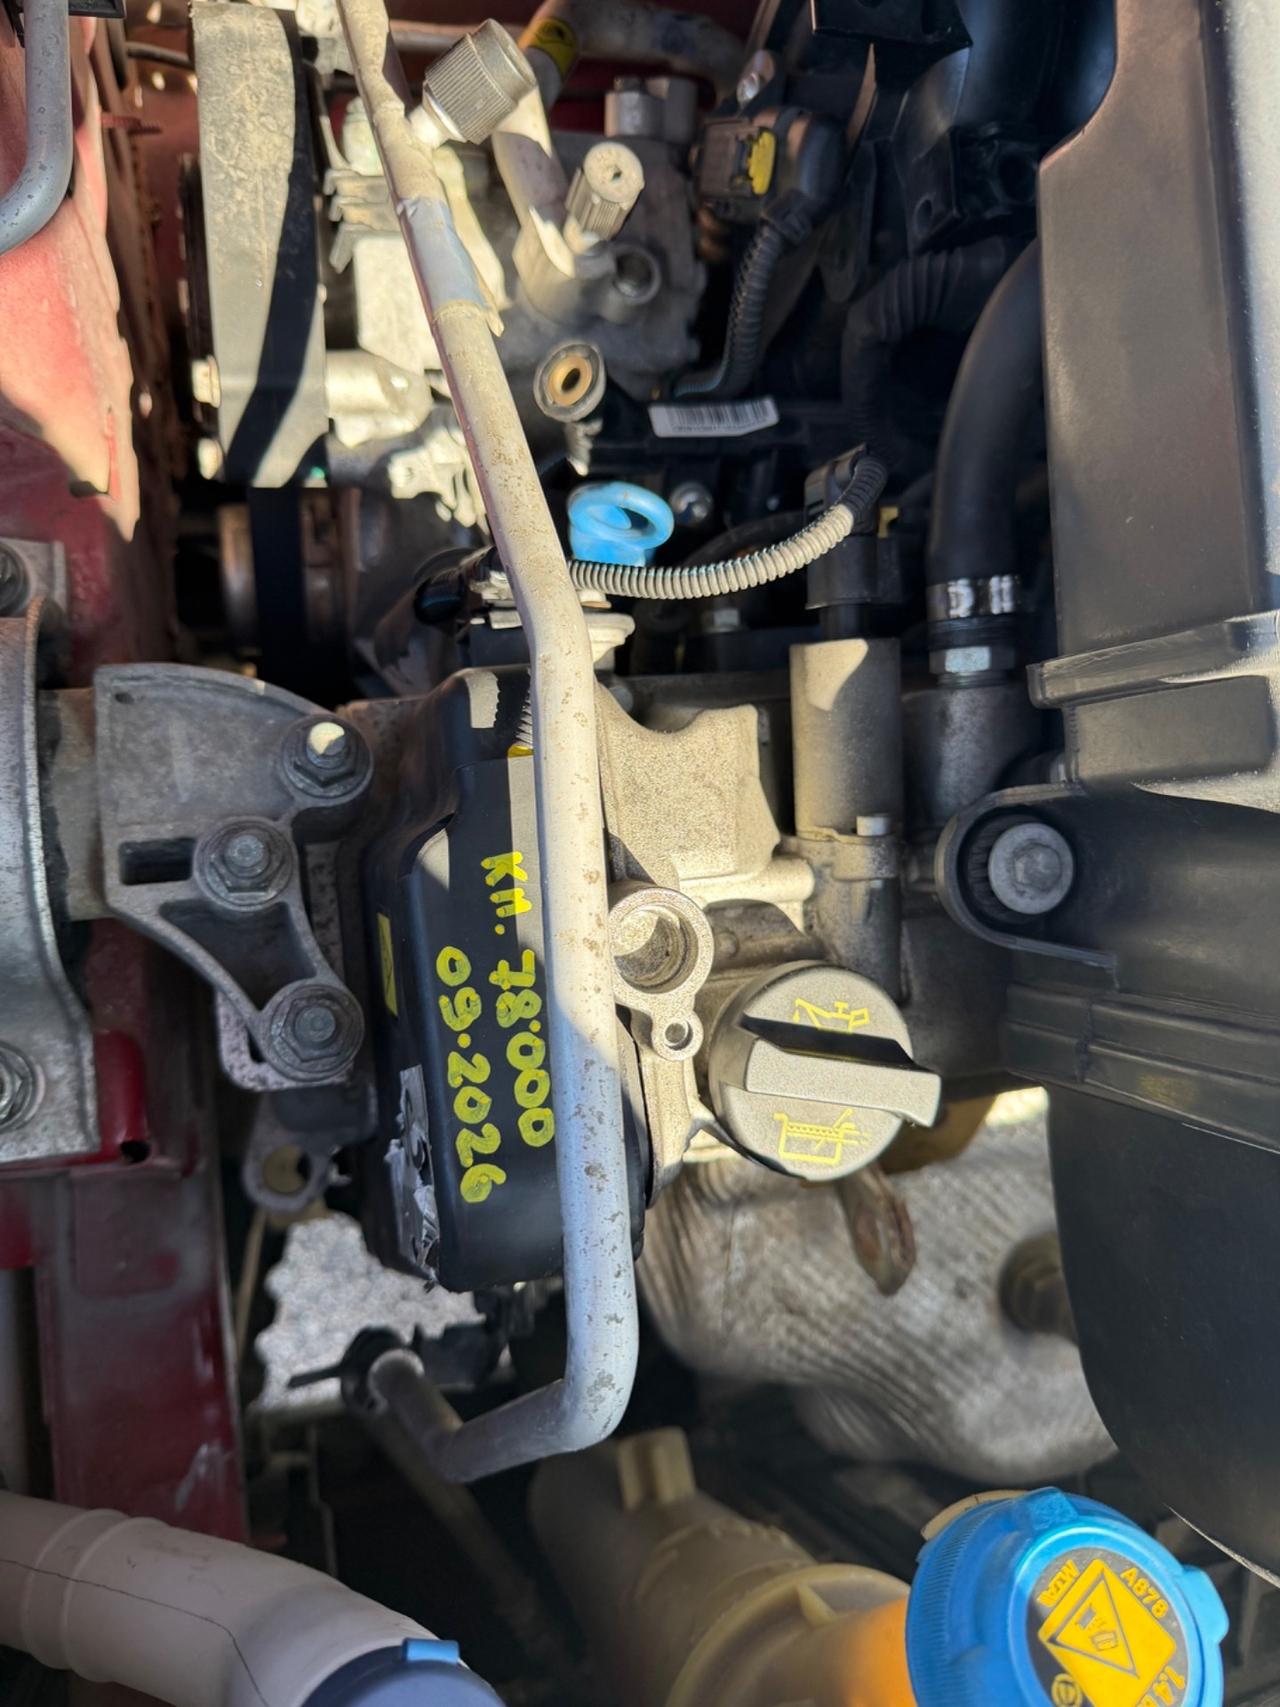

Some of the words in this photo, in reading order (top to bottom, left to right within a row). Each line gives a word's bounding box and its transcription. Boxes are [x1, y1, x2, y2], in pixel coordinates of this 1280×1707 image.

[435, 946, 507, 1203] 09.2026
[488, 949, 554, 1146] 78.000
[1120, 1567, 1169, 1618] A878
